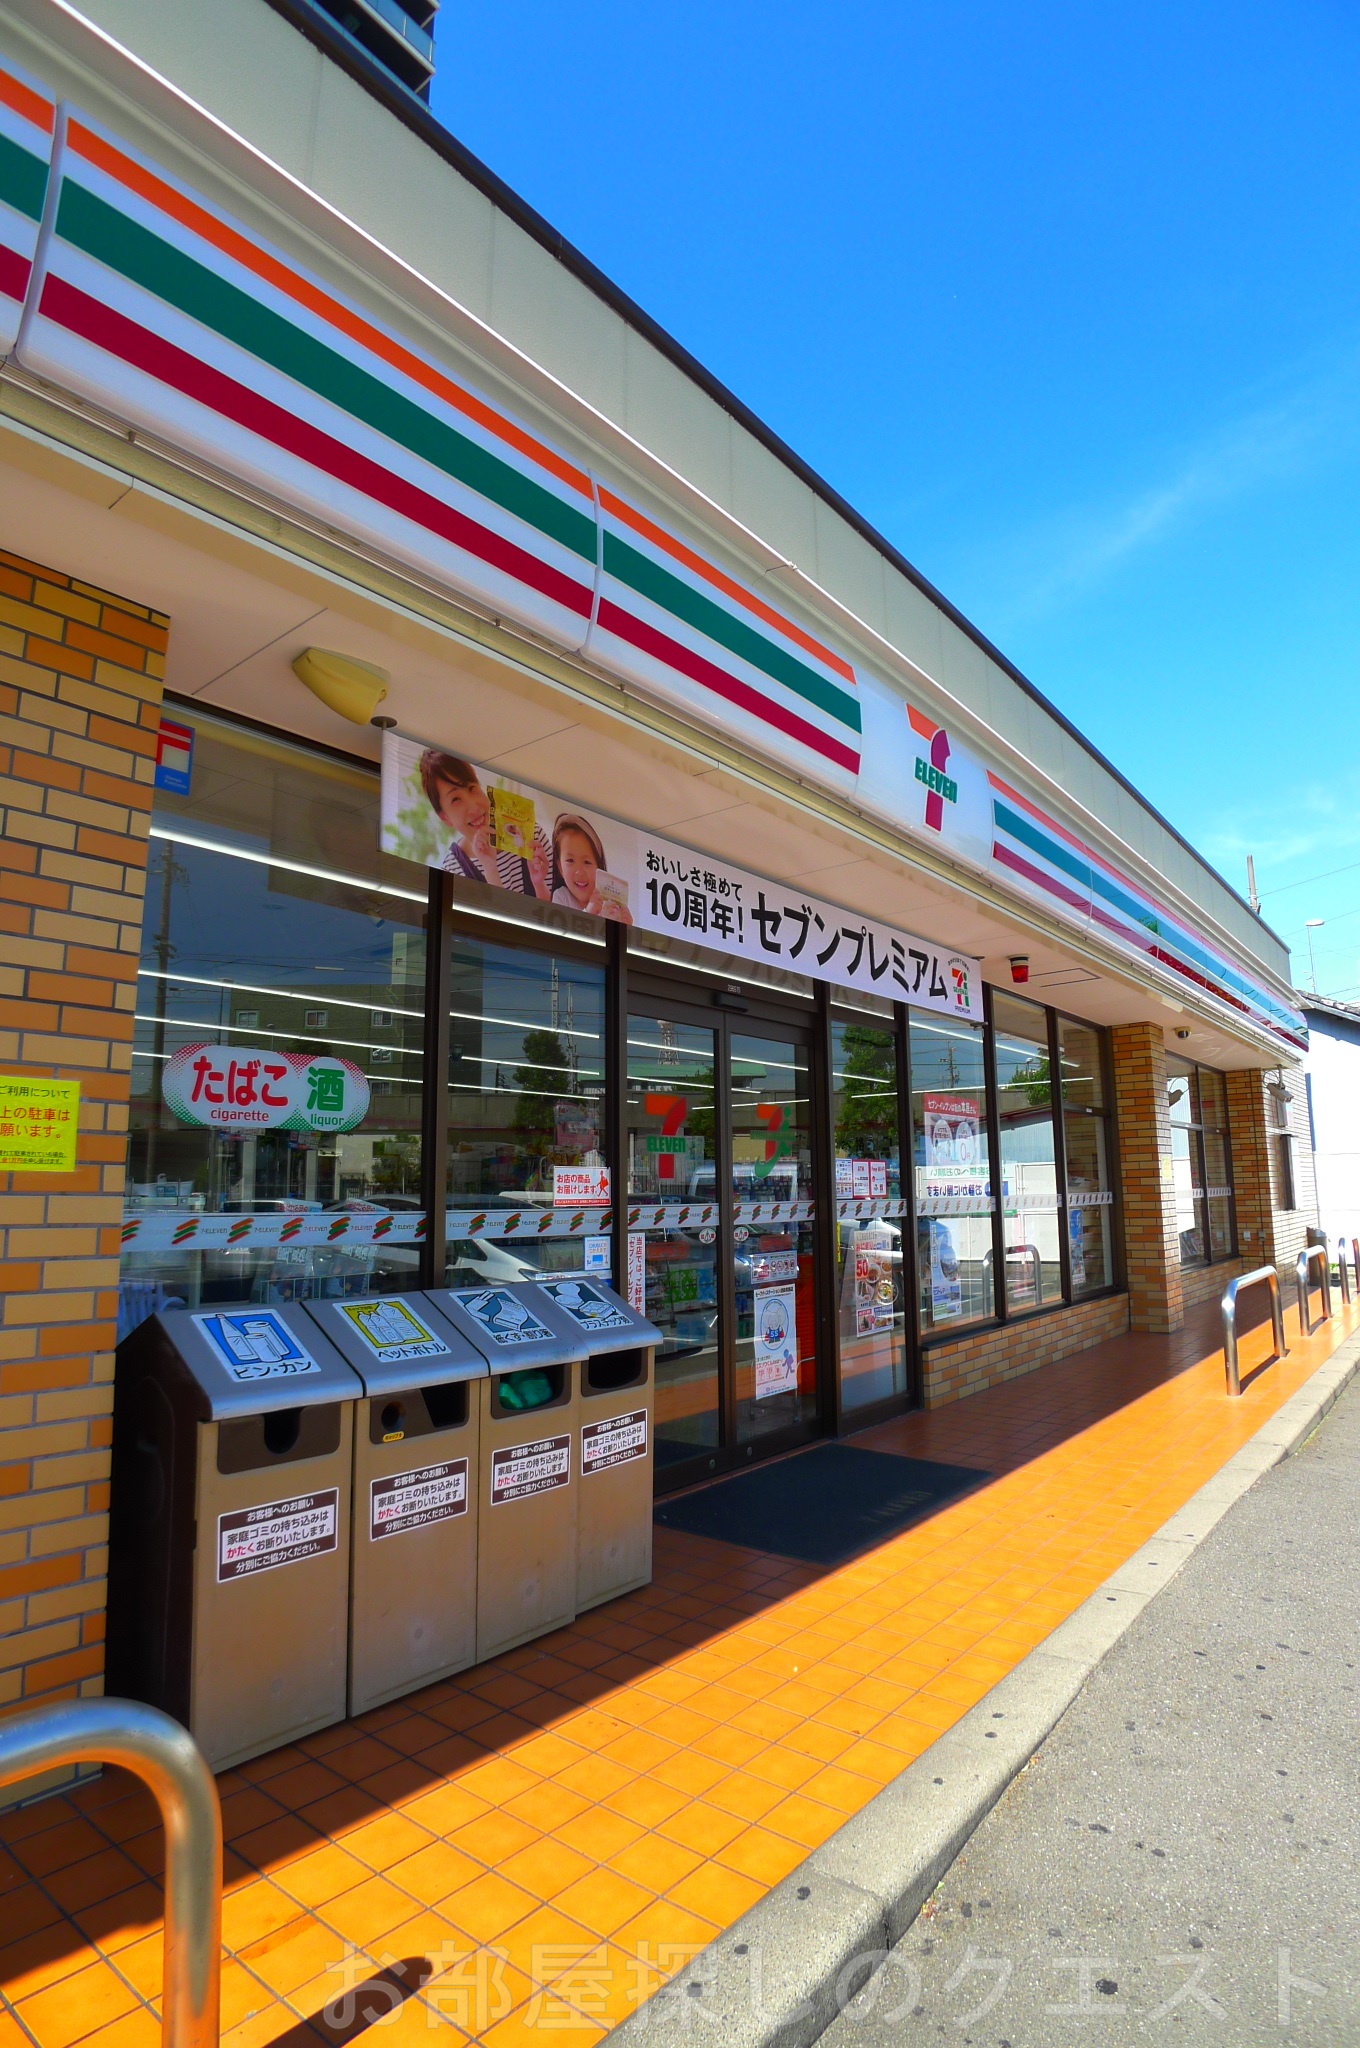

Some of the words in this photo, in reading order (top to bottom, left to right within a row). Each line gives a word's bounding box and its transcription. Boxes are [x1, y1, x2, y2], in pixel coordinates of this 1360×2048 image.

[646, 850, 743, 902] おいしさ極めて
[751, 891, 948, 1001] セブンプレミアム
[191, 1056, 288, 1106] たばこ
[307, 1066, 345, 1112] 酒
[210, 1108, 270, 1122] cigarette
[310, 1113, 345, 1126] liquor
[556, 1174, 591, 1184] お店の商品
[379, 1342, 446, 1358] ペットボトル
[233, 1361, 312, 1379] ビン・カン
[394, 1466, 449, 1487] お客様へのお願い
[497, 1451, 564, 1477] 家庭ゴミの持ち込みは
[378, 1477, 461, 1508] 家庭ゴミの持ち込みは
[247, 1498, 314, 1522] お客様へのお願い
[226, 1523, 331, 1559] かたくお断りいたします。
[227, 1510, 329, 1545] 家庭ゴミの持ち込みは
[235, 1542, 321, 1573] 分別にご協力ください。
